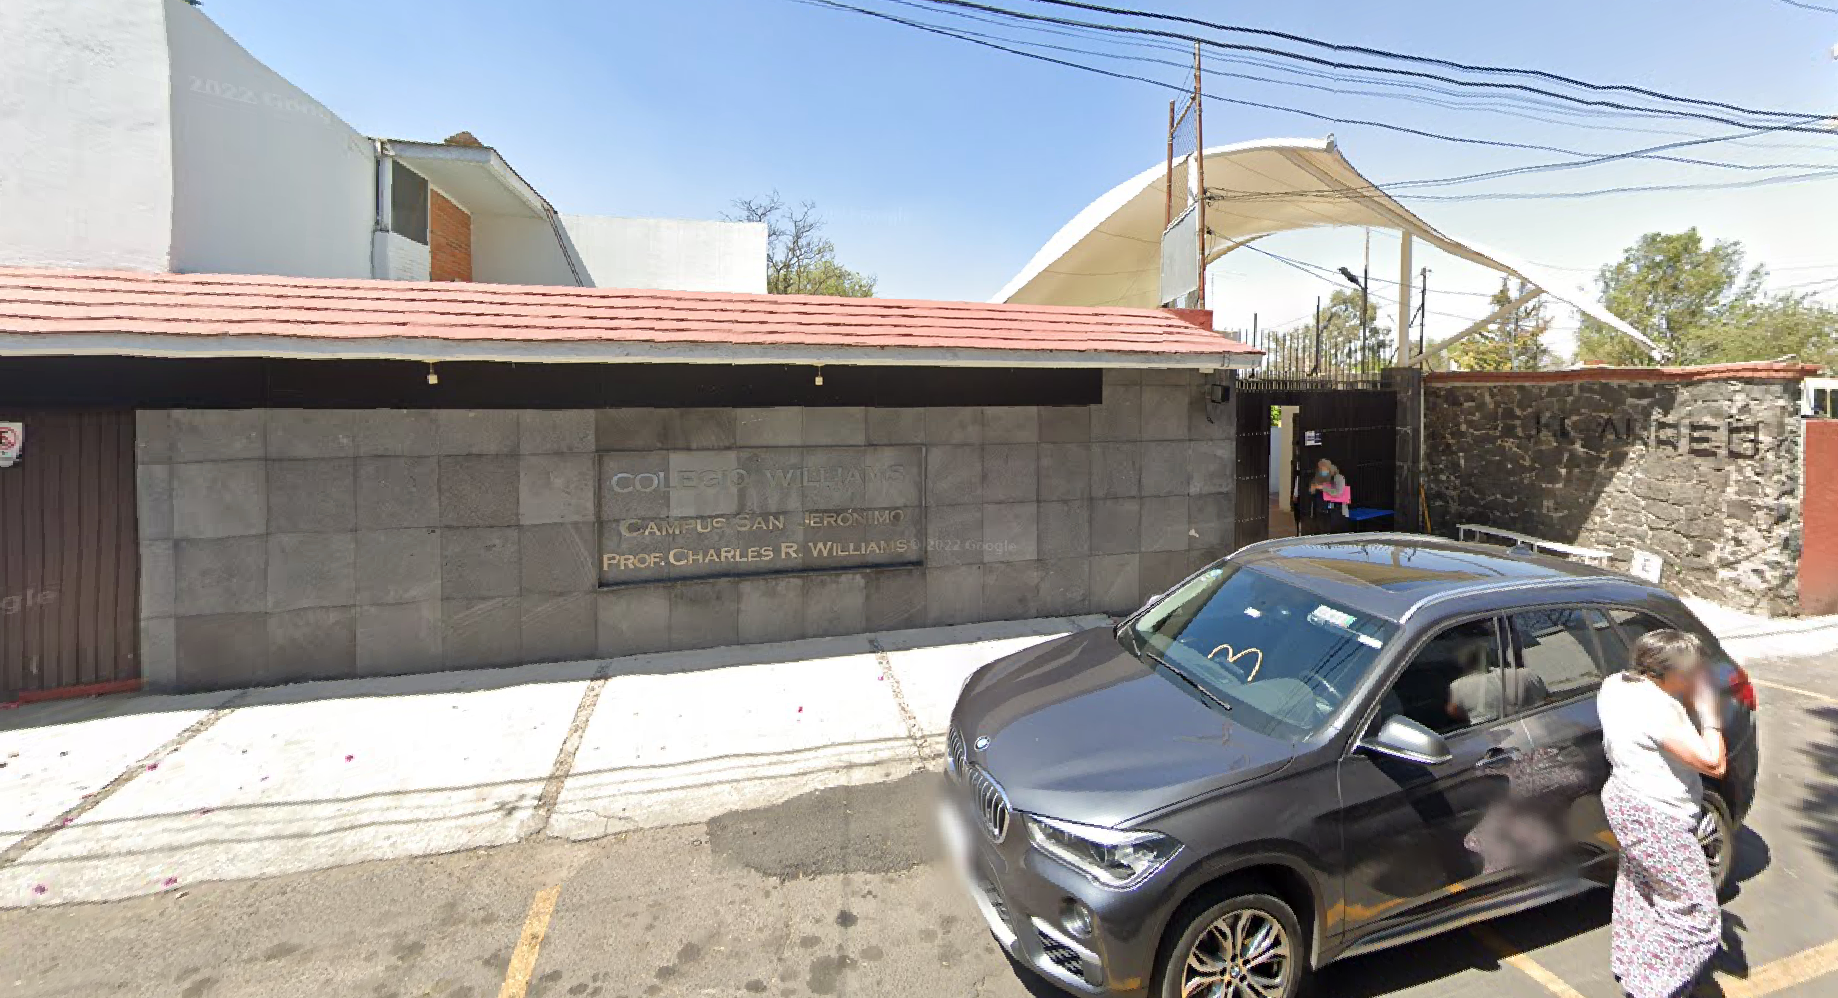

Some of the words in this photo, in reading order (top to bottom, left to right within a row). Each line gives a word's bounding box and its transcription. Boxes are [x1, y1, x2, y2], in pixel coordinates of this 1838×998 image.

[611, 468, 748, 493] COLEGIO
[765, 464, 905, 488] WILLIAMS
[619, 516, 727, 537] CAMPUS
[735, 513, 785, 532] SAN
[799, 508, 905, 530] JERÓNIMO
[602, 553, 665, 571] PROF.
[669, 546, 774, 565] CHARLES
[780, 542, 803, 559] R.
[808, 539, 908, 557] WILLIAMS
